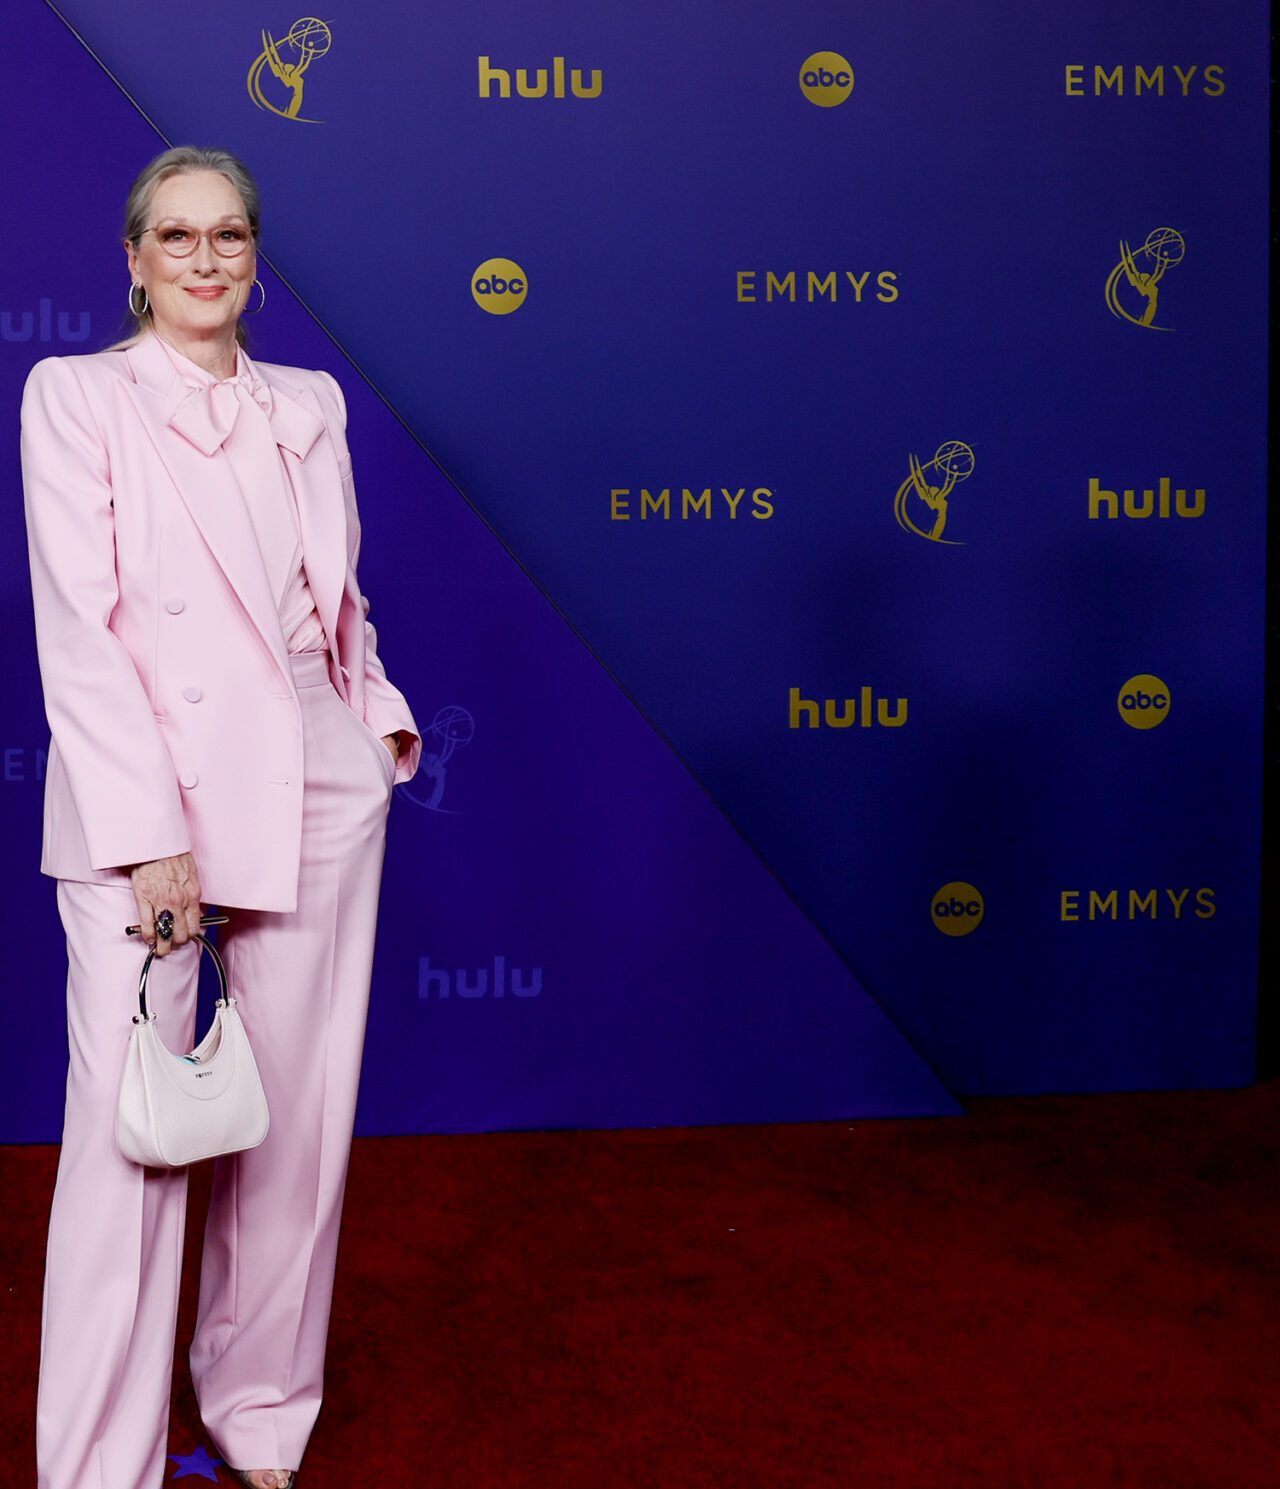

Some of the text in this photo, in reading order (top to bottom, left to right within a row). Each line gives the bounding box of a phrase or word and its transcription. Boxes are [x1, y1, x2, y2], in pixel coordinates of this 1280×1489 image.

[478, 56, 603, 98] hulu
[803, 67, 850, 87] abc
[1065, 65, 1226, 97] EMMYS
[475, 274, 524, 294] abc
[1088, 478, 1206, 519] hulu
[789, 687, 908, 728] hulu
[1122, 690, 1167, 710] abc
[935, 898, 980, 917] abc
[1061, 888, 1218, 921] EMMYS
[418, 956, 543, 999] hulu
